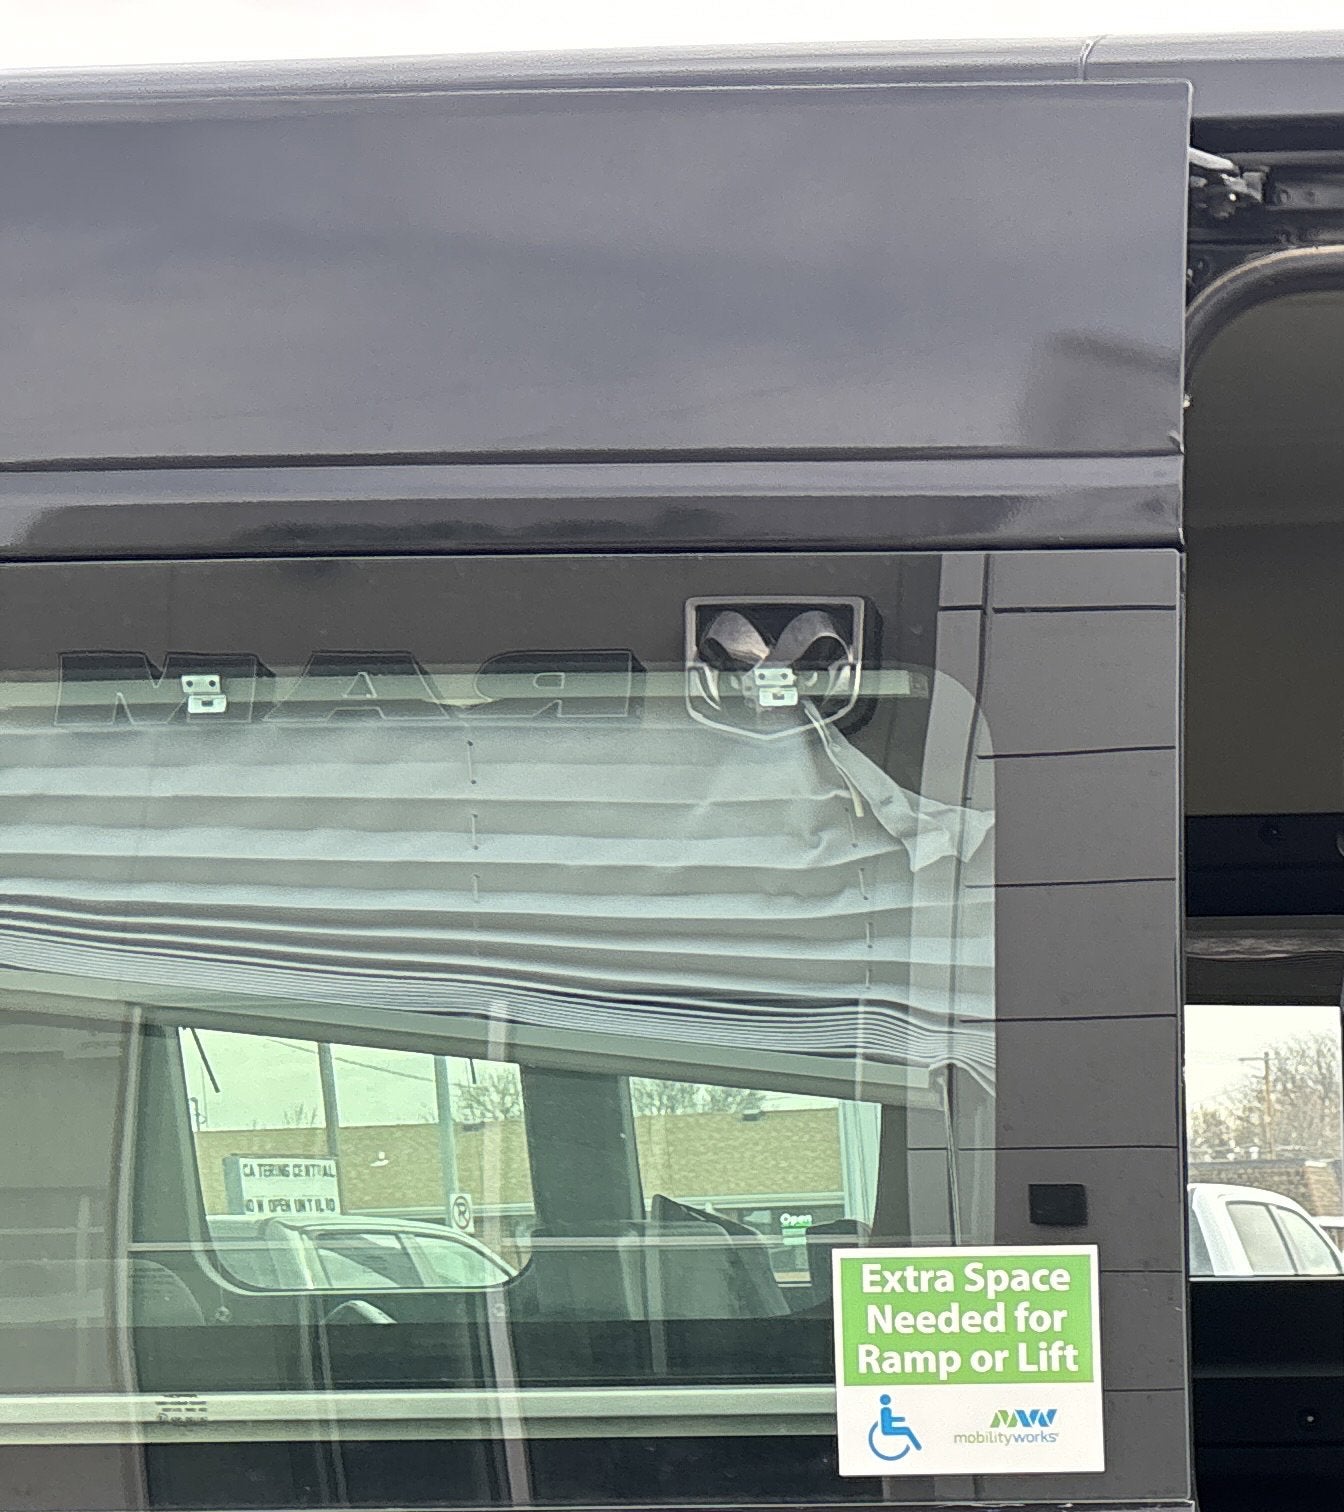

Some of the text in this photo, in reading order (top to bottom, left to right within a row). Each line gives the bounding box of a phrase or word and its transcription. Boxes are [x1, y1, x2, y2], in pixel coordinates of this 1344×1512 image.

[861, 1262, 1072, 1300] Extra Space
[866, 1301, 1068, 1335] Needed for
[857, 1341, 1079, 1381] Ramp or Lift
[953, 1430, 1059, 1446] mobilityworks
